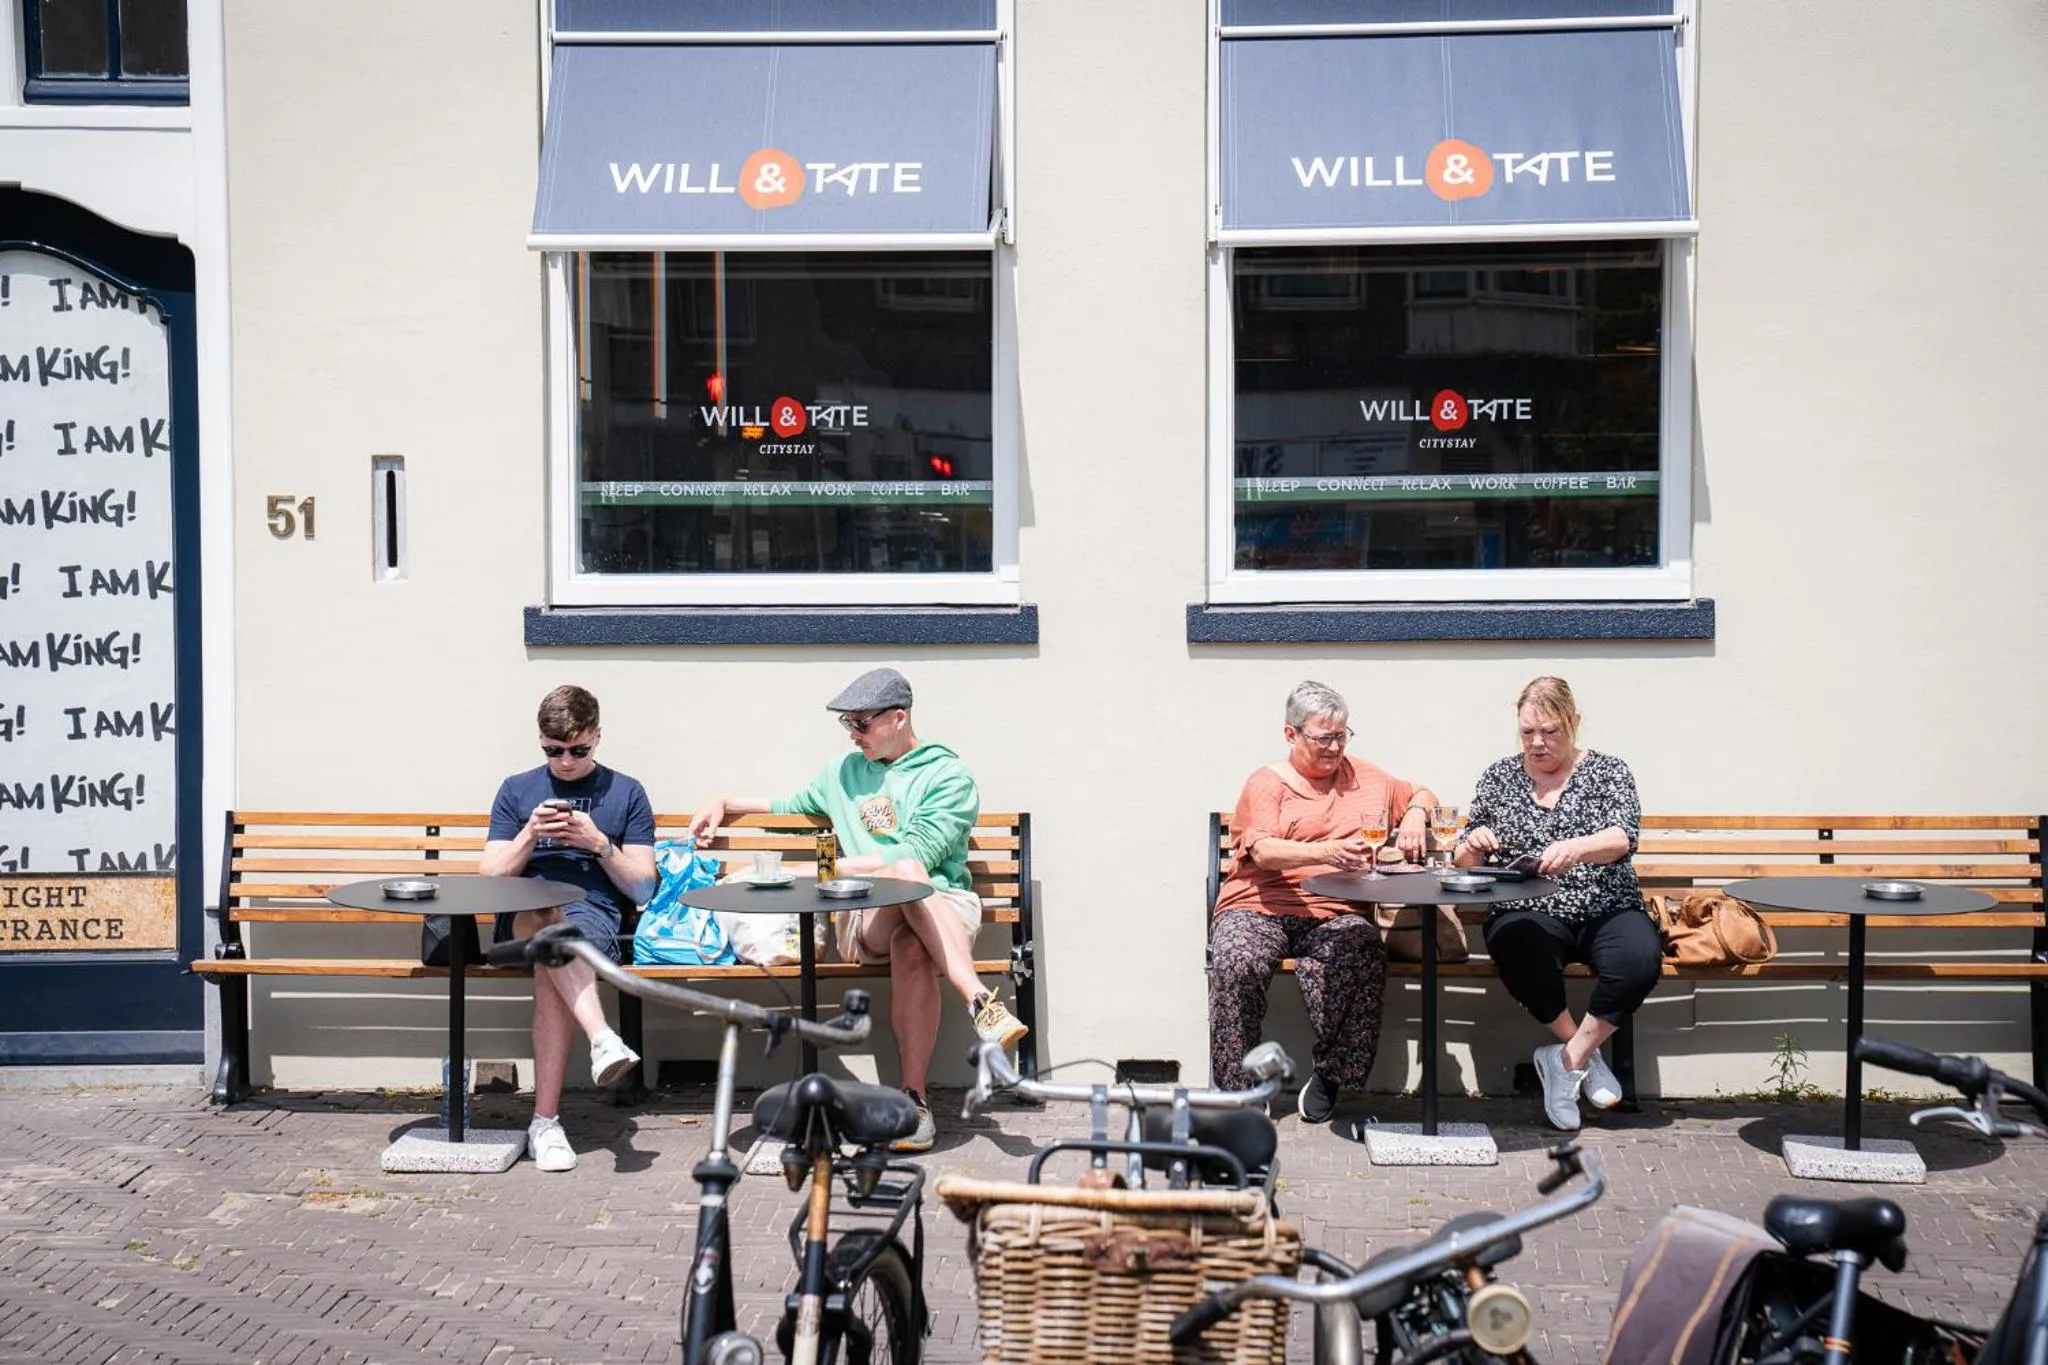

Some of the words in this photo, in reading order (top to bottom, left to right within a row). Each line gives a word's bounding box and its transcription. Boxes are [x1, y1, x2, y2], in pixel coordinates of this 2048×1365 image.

[609, 162, 736, 194] WILL
[754, 162, 787, 194] &
[805, 161, 923, 197] TATE
[1290, 155, 1424, 188] WILL
[1442, 153, 1476, 185] &
[1492, 150, 1617, 187] TATE
[48, 278, 73, 312] I
[80, 281, 129, 310] AM
[0, 354, 31, 382] M
[700, 405, 769, 427] WILL
[779, 407, 798, 427] &
[805, 405, 869, 428] TATE
[1360, 400, 1430, 422] WILL
[1439, 399, 1458, 421] &
[1467, 398, 1532, 422] TATE
[53, 421, 77, 455] I
[84, 425, 134, 454] AM
[759, 443, 816, 456] CITYSTAY
[1418, 437, 1477, 450] CITYSTAY
[660, 483, 726, 497] CONNECT
[742, 482, 792, 496] RELAX
[808, 482, 855, 496] WORK
[870, 482, 925, 496] COFFEE
[940, 482, 970, 496] BAR
[1316, 477, 1388, 492] CONNECT
[1401, 477, 1452, 491] RELAX
[1468, 476, 1518, 491] WORK
[1533, 475, 1590, 490] COFFEE
[1605, 475, 1638, 490] BAR
[266, 495, 315, 541] 51
[58, 564, 82, 599] I
[89, 568, 140, 597] AM
[63, 706, 87, 741] I
[94, 710, 144, 738] AM
[0, 782, 44, 811] AM
